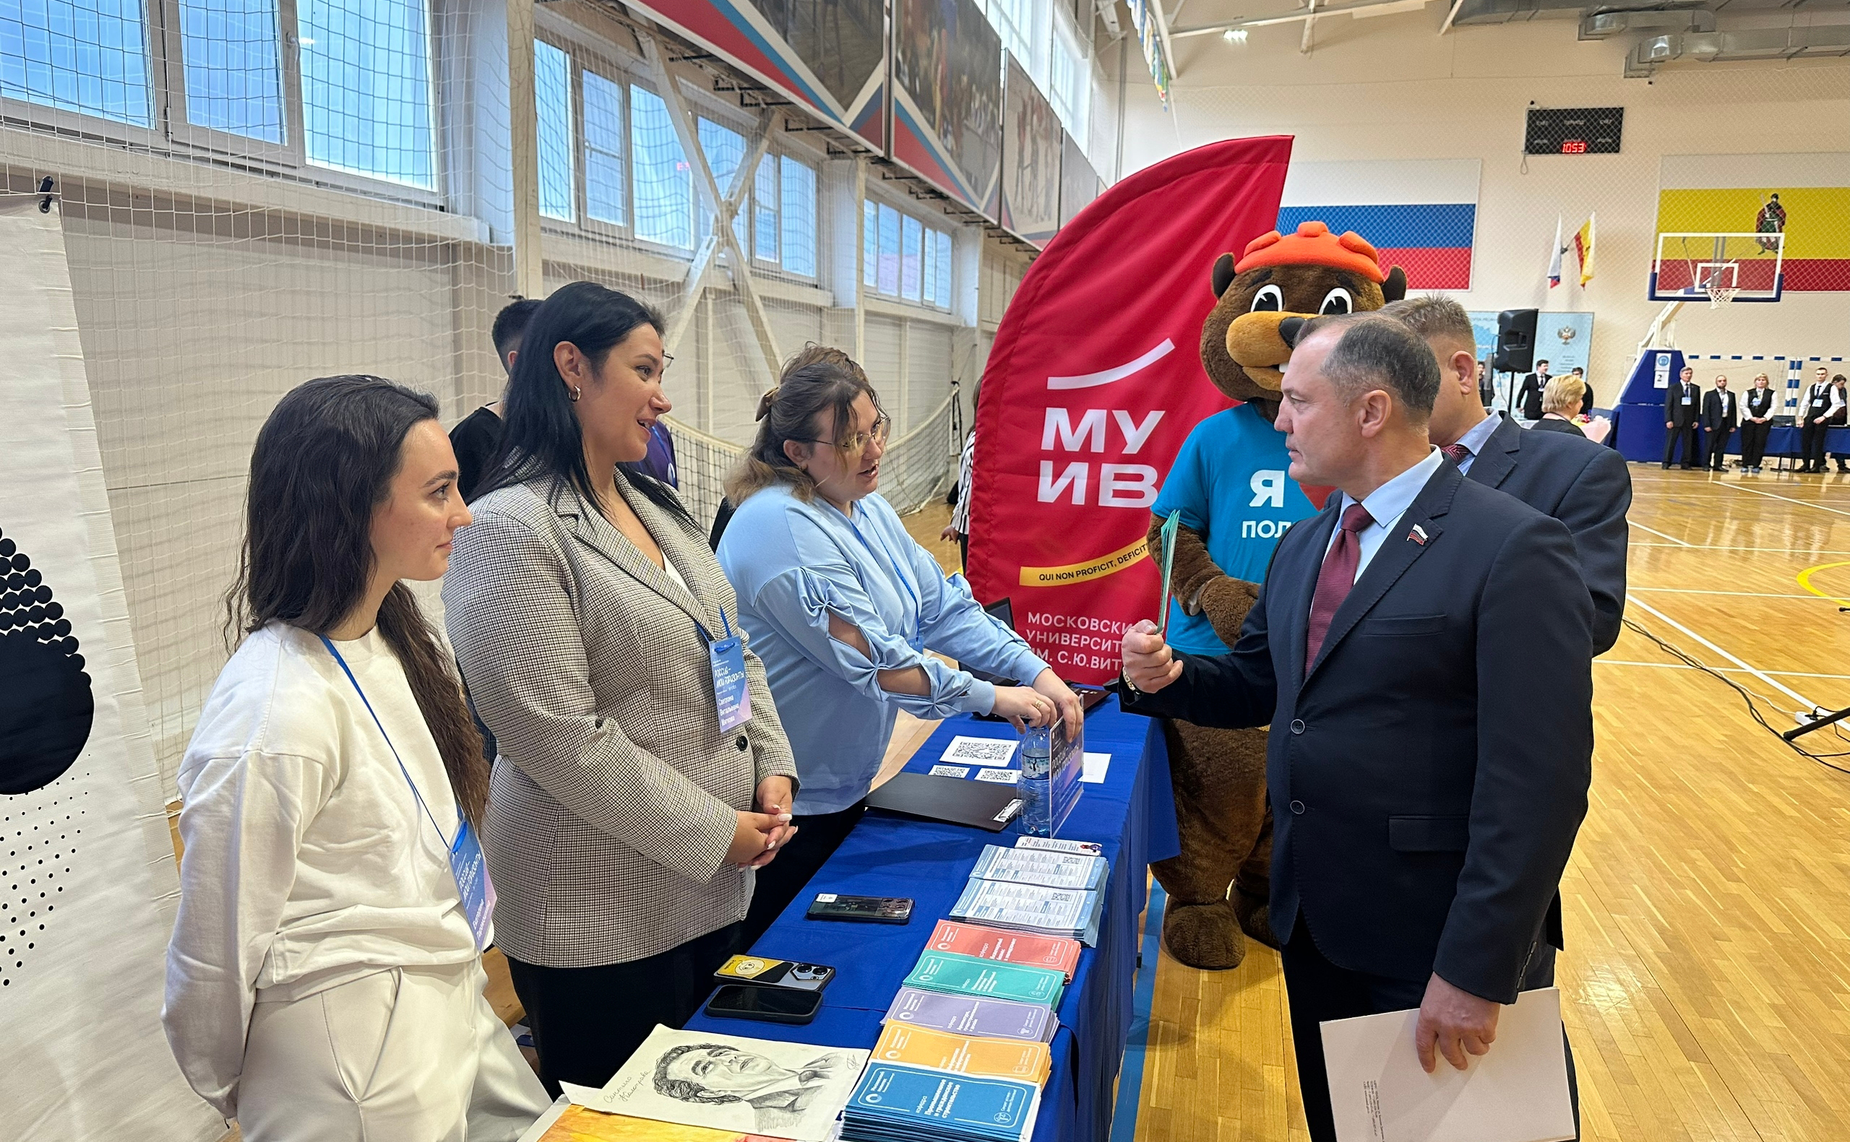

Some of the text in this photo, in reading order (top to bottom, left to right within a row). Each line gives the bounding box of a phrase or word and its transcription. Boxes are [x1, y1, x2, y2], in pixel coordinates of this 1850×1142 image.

[1041, 407, 1165, 455] МУ
[1037, 461, 1159, 508] ИВ
[1249, 470, 1285, 508] Я
[1242, 520, 1296, 539] ПОЛ
[1039, 544, 1147, 581] QUI NON PROFICIT, DEFICIT
[1032, 647, 1121, 670] М. С.Ю.ВИТ
